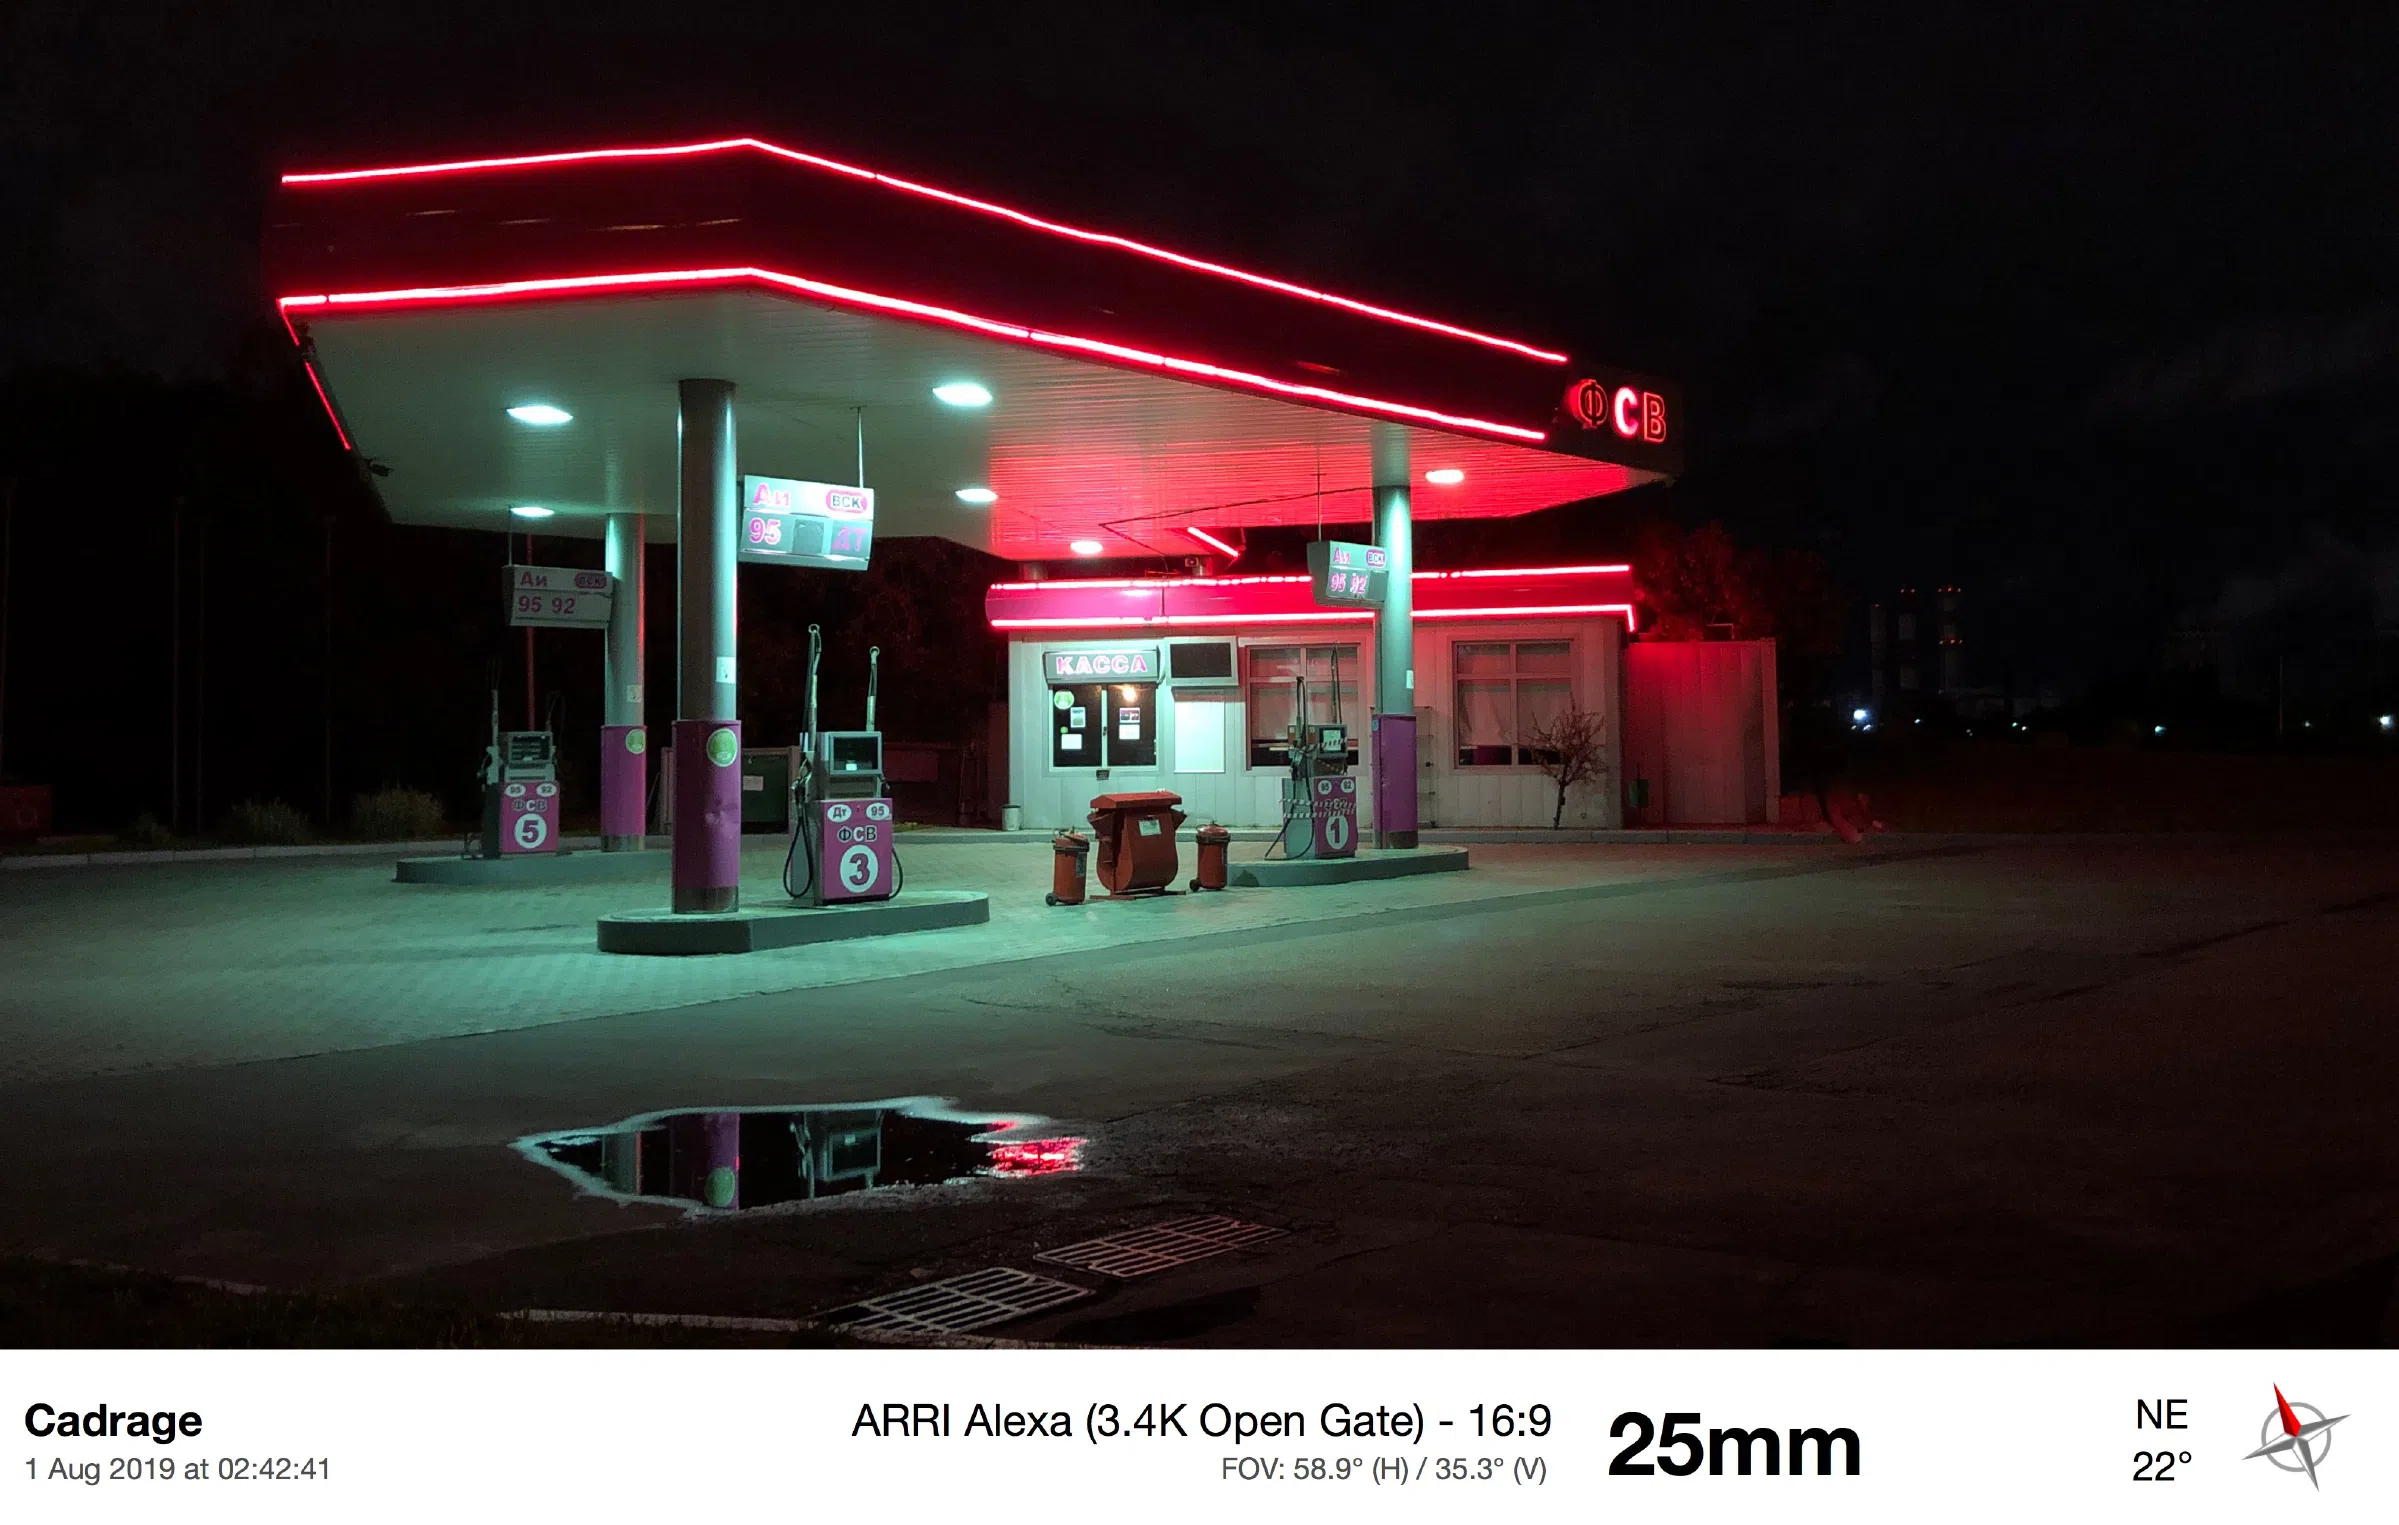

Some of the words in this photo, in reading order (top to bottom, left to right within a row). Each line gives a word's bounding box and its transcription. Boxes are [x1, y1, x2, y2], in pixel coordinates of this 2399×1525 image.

[1575, 379, 1667, 443] ФСВ
[832, 494, 861, 509] ВСК
[749, 517, 782, 545] 95
[521, 571, 548, 587] Аи
[1330, 572, 1346, 592] 95
[518, 595, 542, 613] 95
[551, 597, 576, 615] 92
[1056, 655, 1148, 675] КАССА
[511, 799, 548, 812] ФСВ
[832, 806, 847, 819] Дт
[870, 805, 885, 817] 95
[521, 819, 540, 844] 5
[837, 824, 878, 843] ФСВ
[1329, 817, 1341, 844] 1
[849, 852, 871, 886] 3
